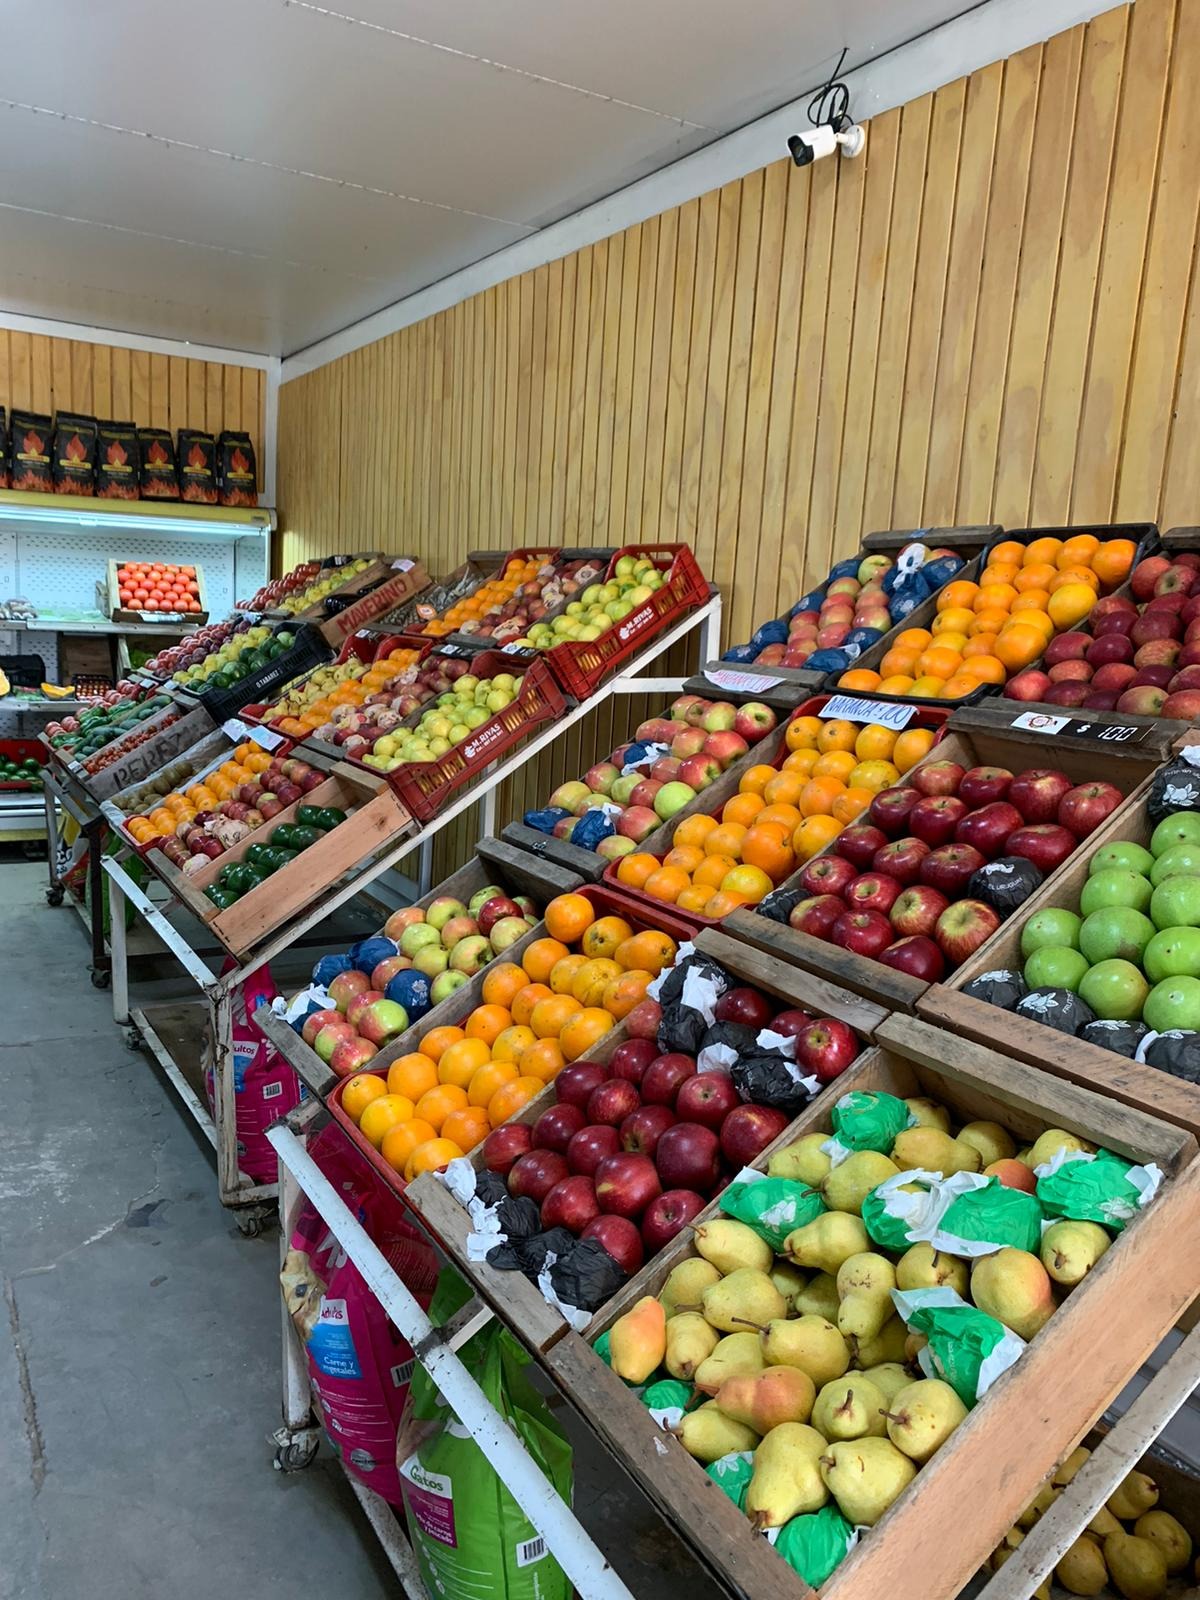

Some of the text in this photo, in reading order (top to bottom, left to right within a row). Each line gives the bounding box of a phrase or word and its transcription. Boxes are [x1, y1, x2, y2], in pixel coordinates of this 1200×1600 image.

[823, 696, 880, 718] NARANJA
[471, 722, 502, 749] M.RIVAS
[1076, 724, 1139, 742] $ 100
[410, 1464, 444, 1492] Gatos
